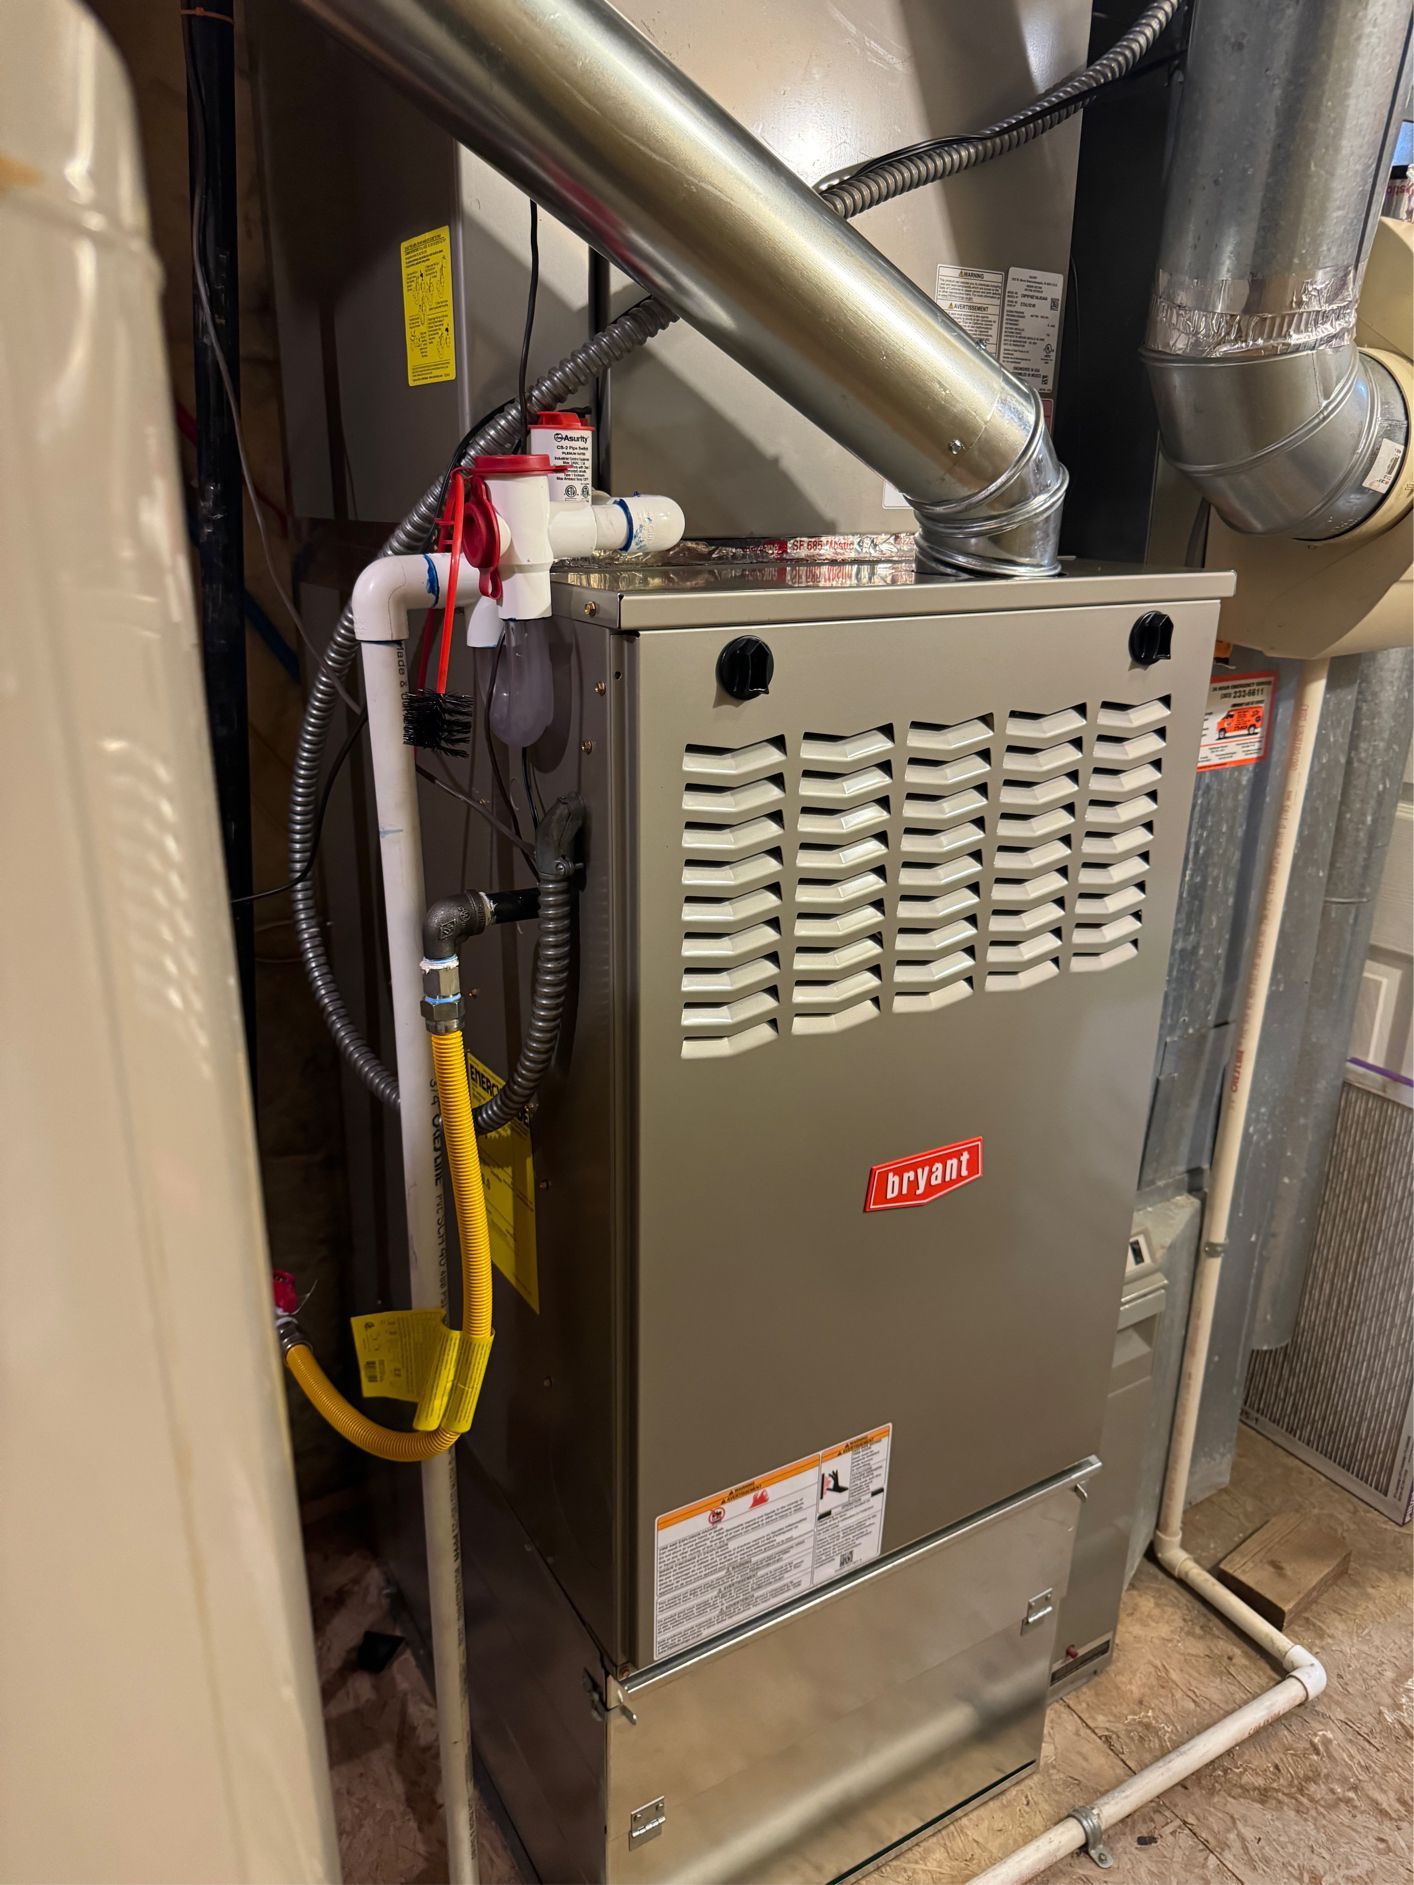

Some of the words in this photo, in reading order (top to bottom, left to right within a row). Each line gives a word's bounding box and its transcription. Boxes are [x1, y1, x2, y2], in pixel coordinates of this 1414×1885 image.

[564, 434, 588, 444] Asurity
[793, 540, 805, 551] SF
[807, 540, 823, 551] 685
[886, 1151, 970, 1200] bryant
